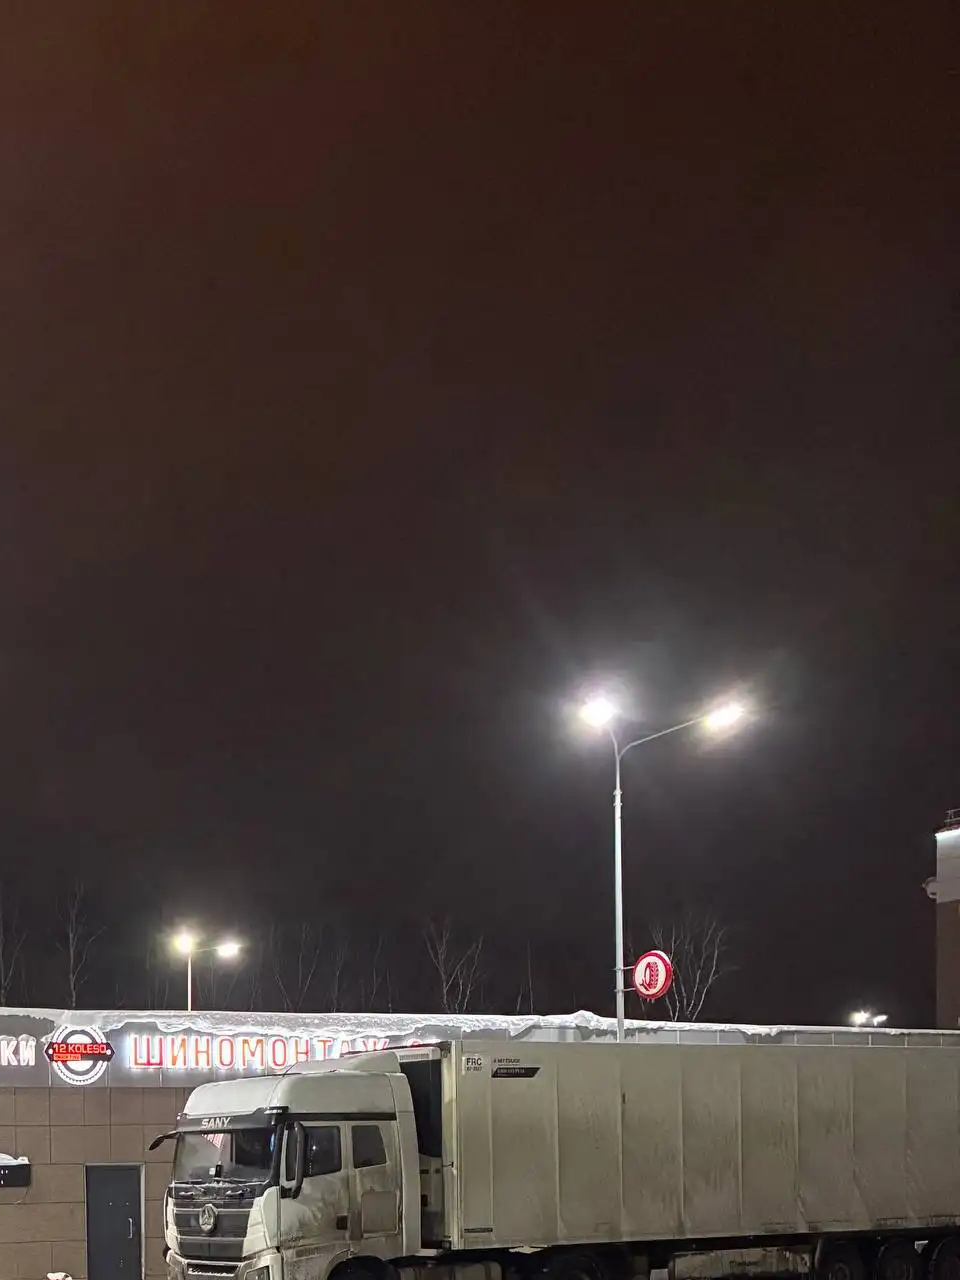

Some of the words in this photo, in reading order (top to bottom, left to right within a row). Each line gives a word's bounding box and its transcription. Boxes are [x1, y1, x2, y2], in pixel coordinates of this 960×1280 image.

[53, 1044, 67, 1053] 12
[69, 1044, 107, 1054] KOLESO
[466, 1057, 482, 1066] FRC
[201, 1116, 231, 1129] SANY
